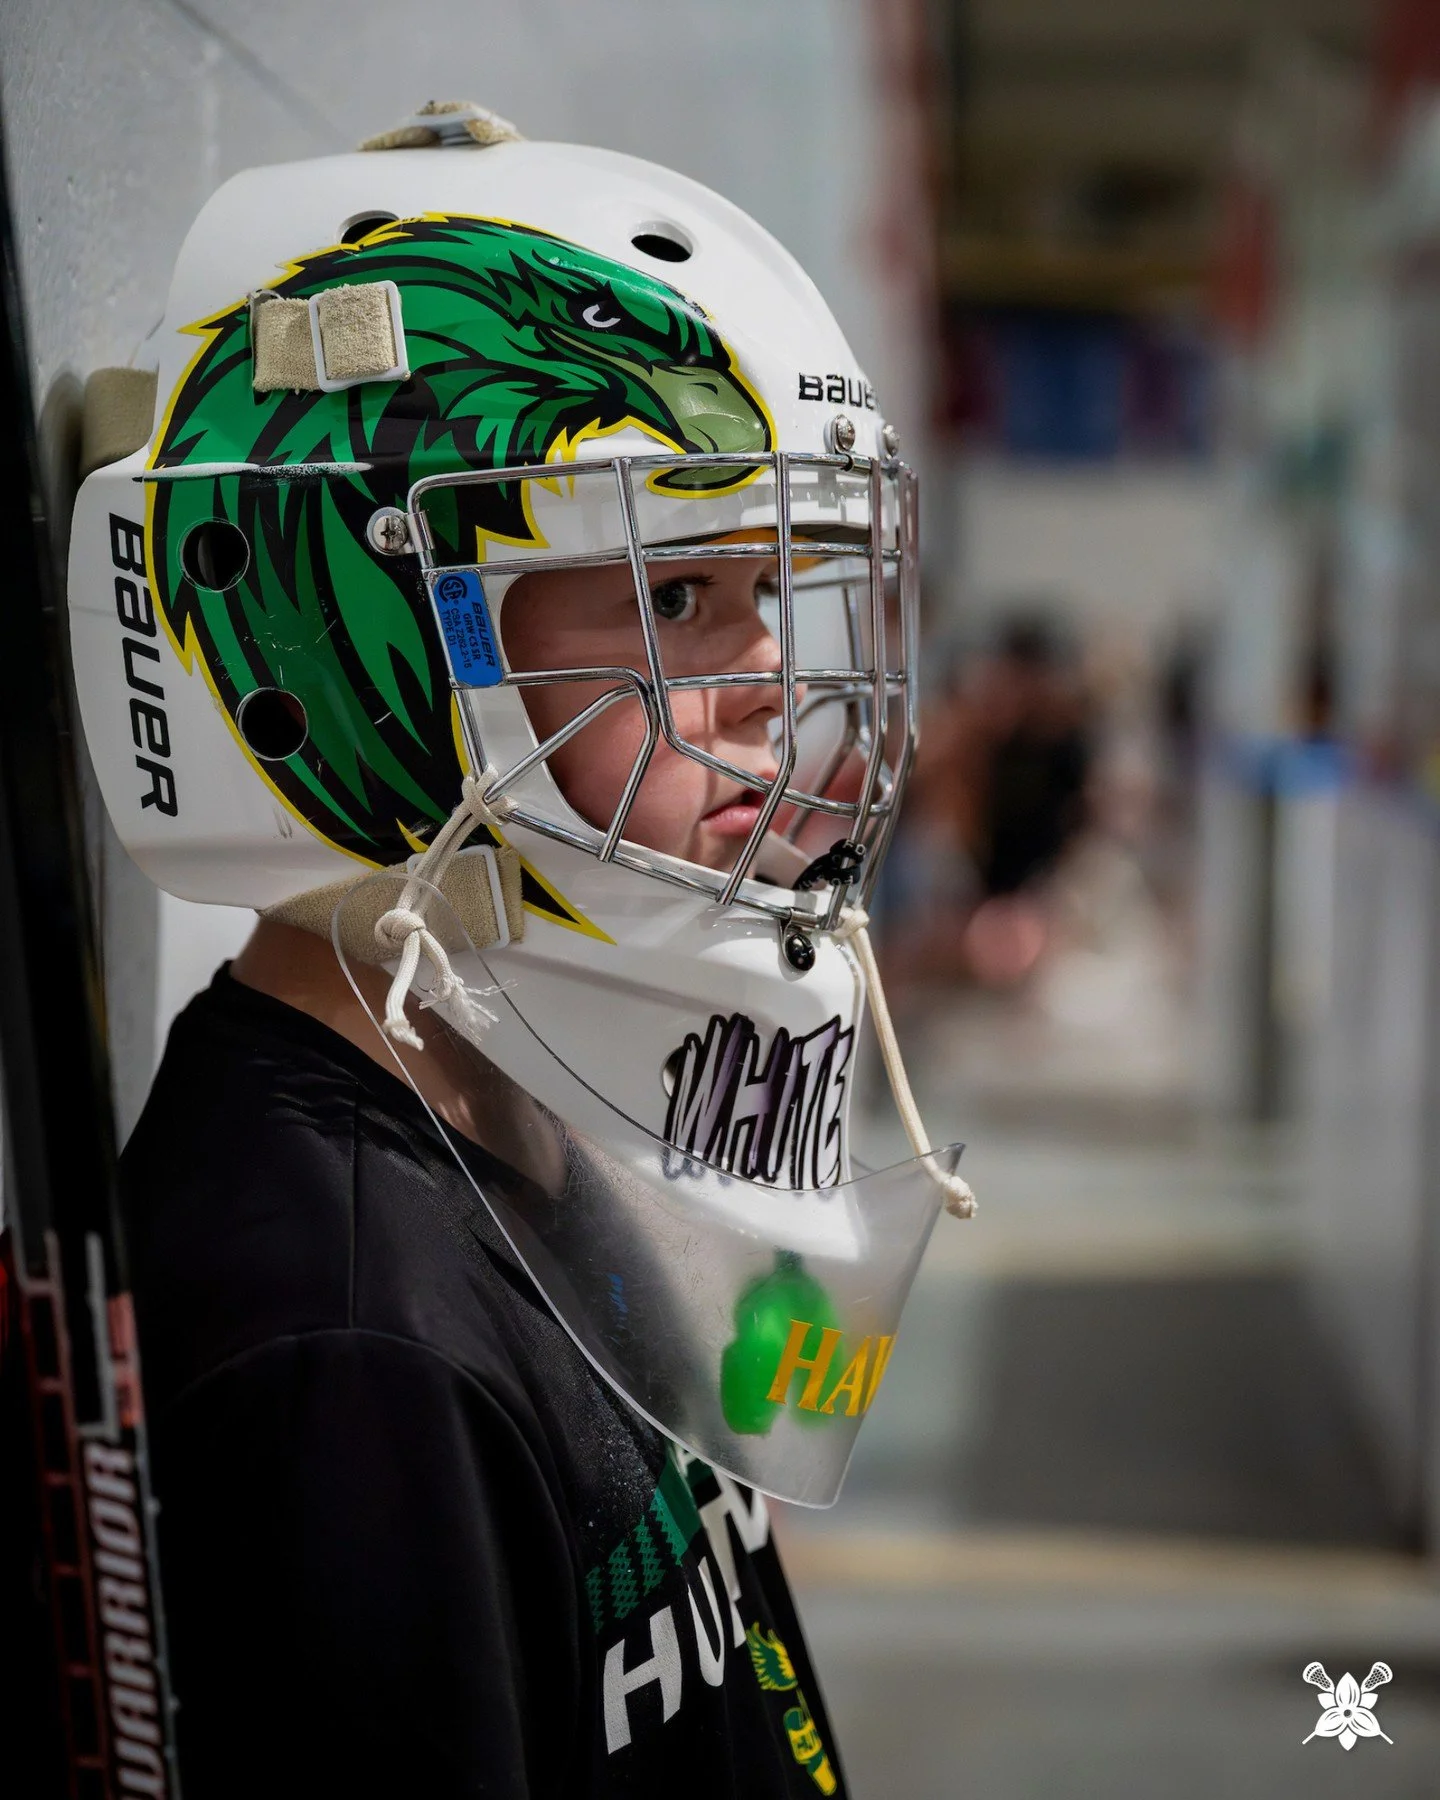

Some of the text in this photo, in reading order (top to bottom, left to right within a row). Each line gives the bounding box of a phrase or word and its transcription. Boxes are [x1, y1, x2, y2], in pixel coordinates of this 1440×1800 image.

[798, 372, 880, 411] BAUE
[441, 609, 455, 634] TYPE
[472, 601, 496, 668] BAUER
[108, 512, 178, 817] BAUER
